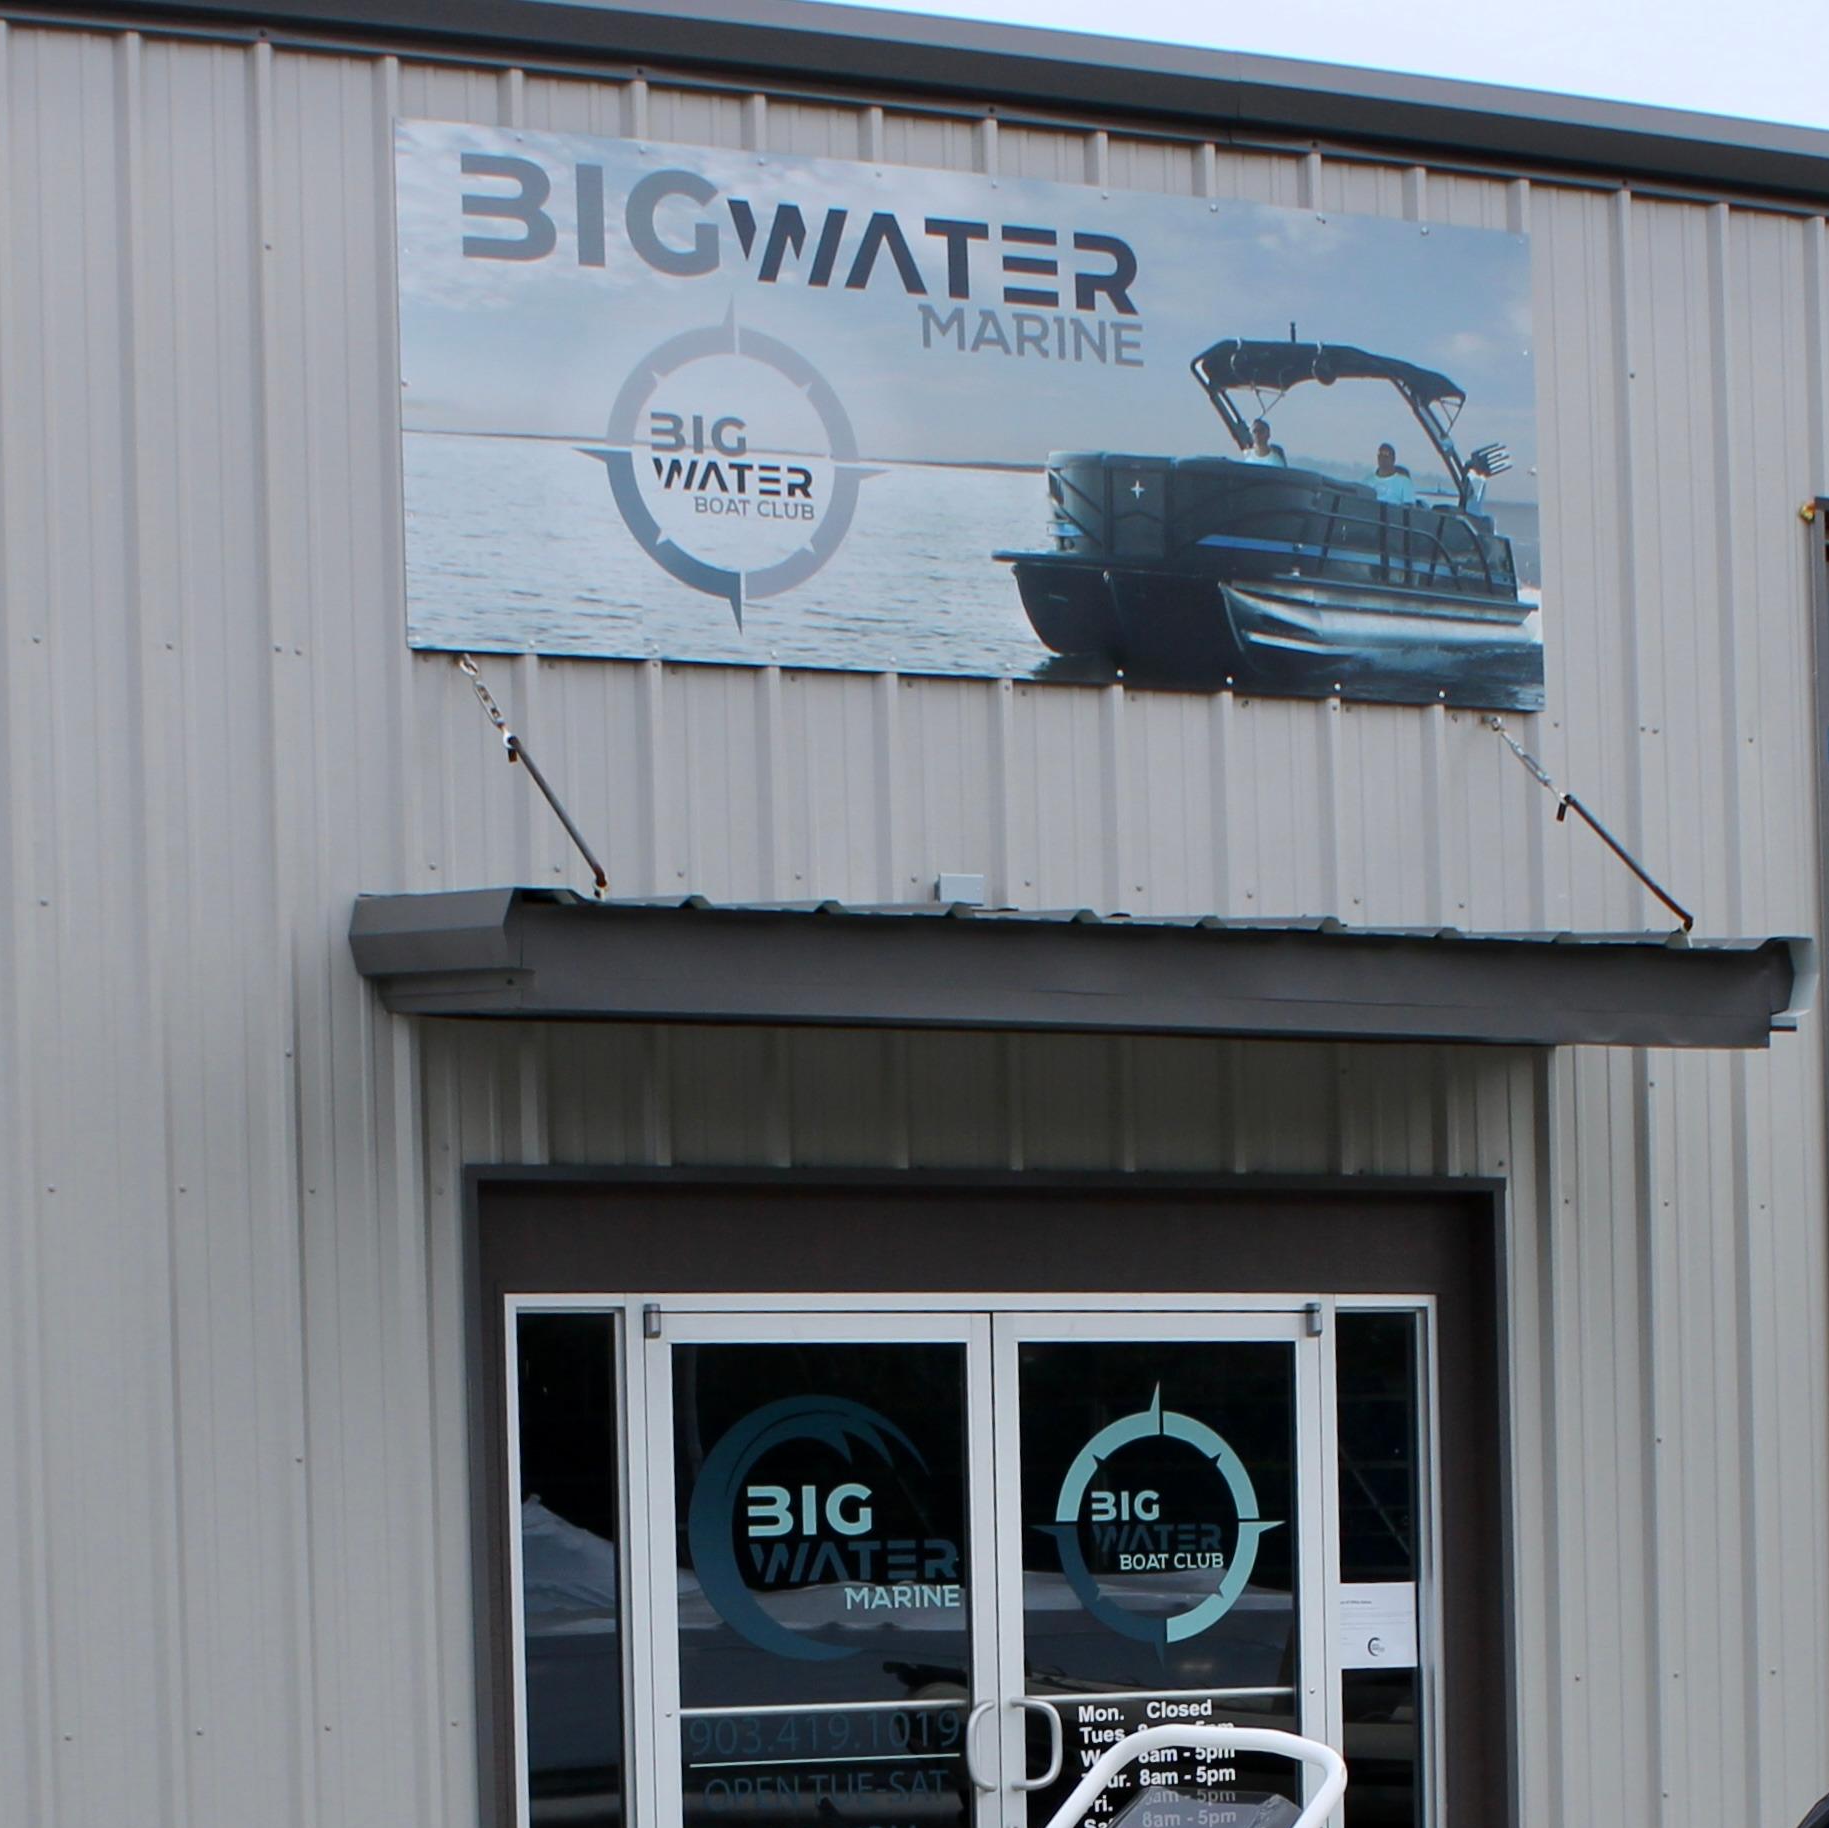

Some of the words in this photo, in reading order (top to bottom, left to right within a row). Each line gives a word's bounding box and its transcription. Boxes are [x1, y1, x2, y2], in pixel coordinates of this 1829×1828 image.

[917, 303, 1145, 367] MARINE
[650, 411, 747, 457] BIG
[652, 457, 813, 499] WATER
[693, 496, 751, 517] BOAT
[757, 500, 815, 521] CLUB
[747, 1483, 872, 1537] BIG
[1091, 1490, 1160, 1521] BIG
[1091, 1523, 1221, 1552] WATER
[749, 1538, 958, 1584] WATER
[1120, 1553, 1170, 1570] BOAT
[1174, 1552, 1224, 1569] CLUB
[844, 1584, 961, 1610] MARINE
[1078, 1705, 1125, 1723] Mon.
[1146, 1699, 1213, 1719] Closed
[689, 1709, 961, 1758] 903.419.1019
[1195, 1746, 1236, 1764] 5pm
[704, 1775, 800, 1811] OPEN
[808, 1769, 950, 1807] TUE-SAT
[1139, 1768, 1179, 1786] 8am
[1196, 1766, 1236, 1786] 5pm
[1092, 1795, 1114, 1813] ri.
[1196, 1788, 1236, 1807] 5pm
[1142, 1811, 1181, 1828] 8am
[1198, 1810, 1237, 1828] 5pm
